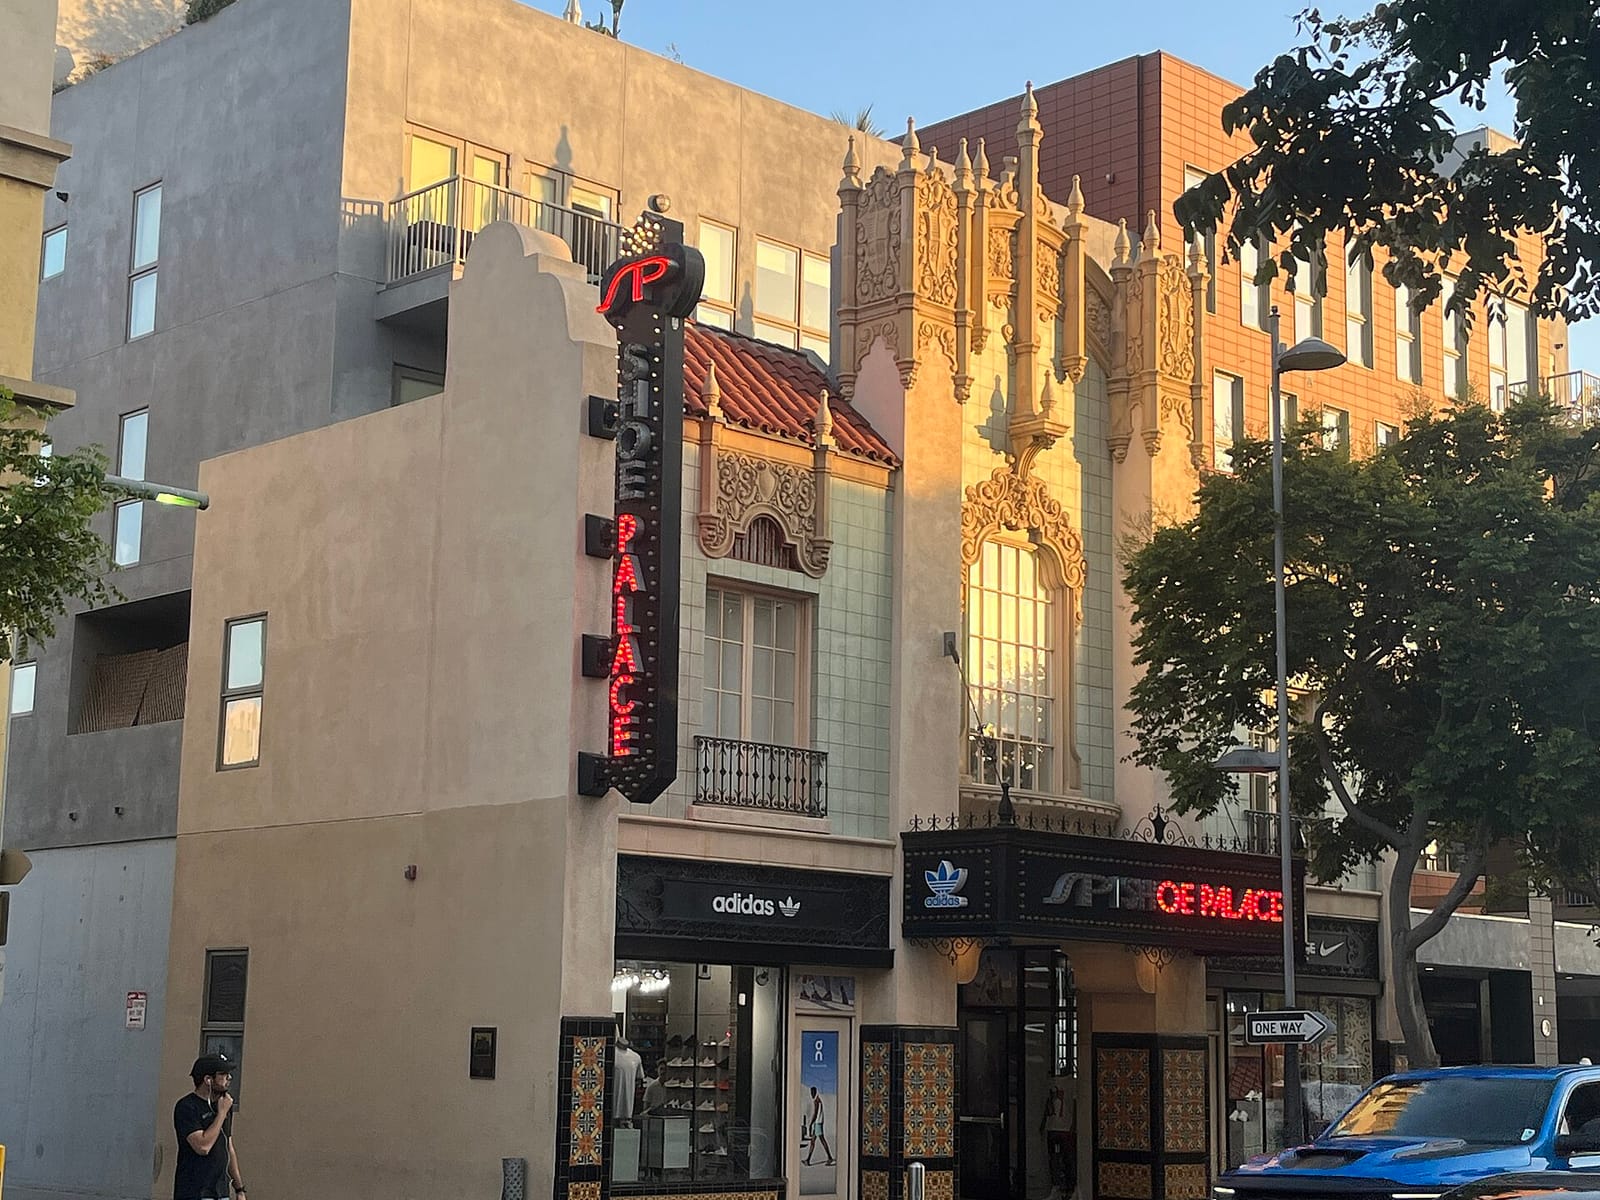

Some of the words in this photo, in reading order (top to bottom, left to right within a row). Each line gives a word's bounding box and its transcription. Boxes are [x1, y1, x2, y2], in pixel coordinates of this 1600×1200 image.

[616, 343, 651, 501] SHOE
[610, 513, 643, 757] PALACE
[712, 892, 775, 916] adidas
[925, 893, 961, 907] adidas
[1199, 882, 1284, 923] PALACE
[1255, 1022, 1277, 1034] ONE
[1279, 1021, 1303, 1034] WAY
